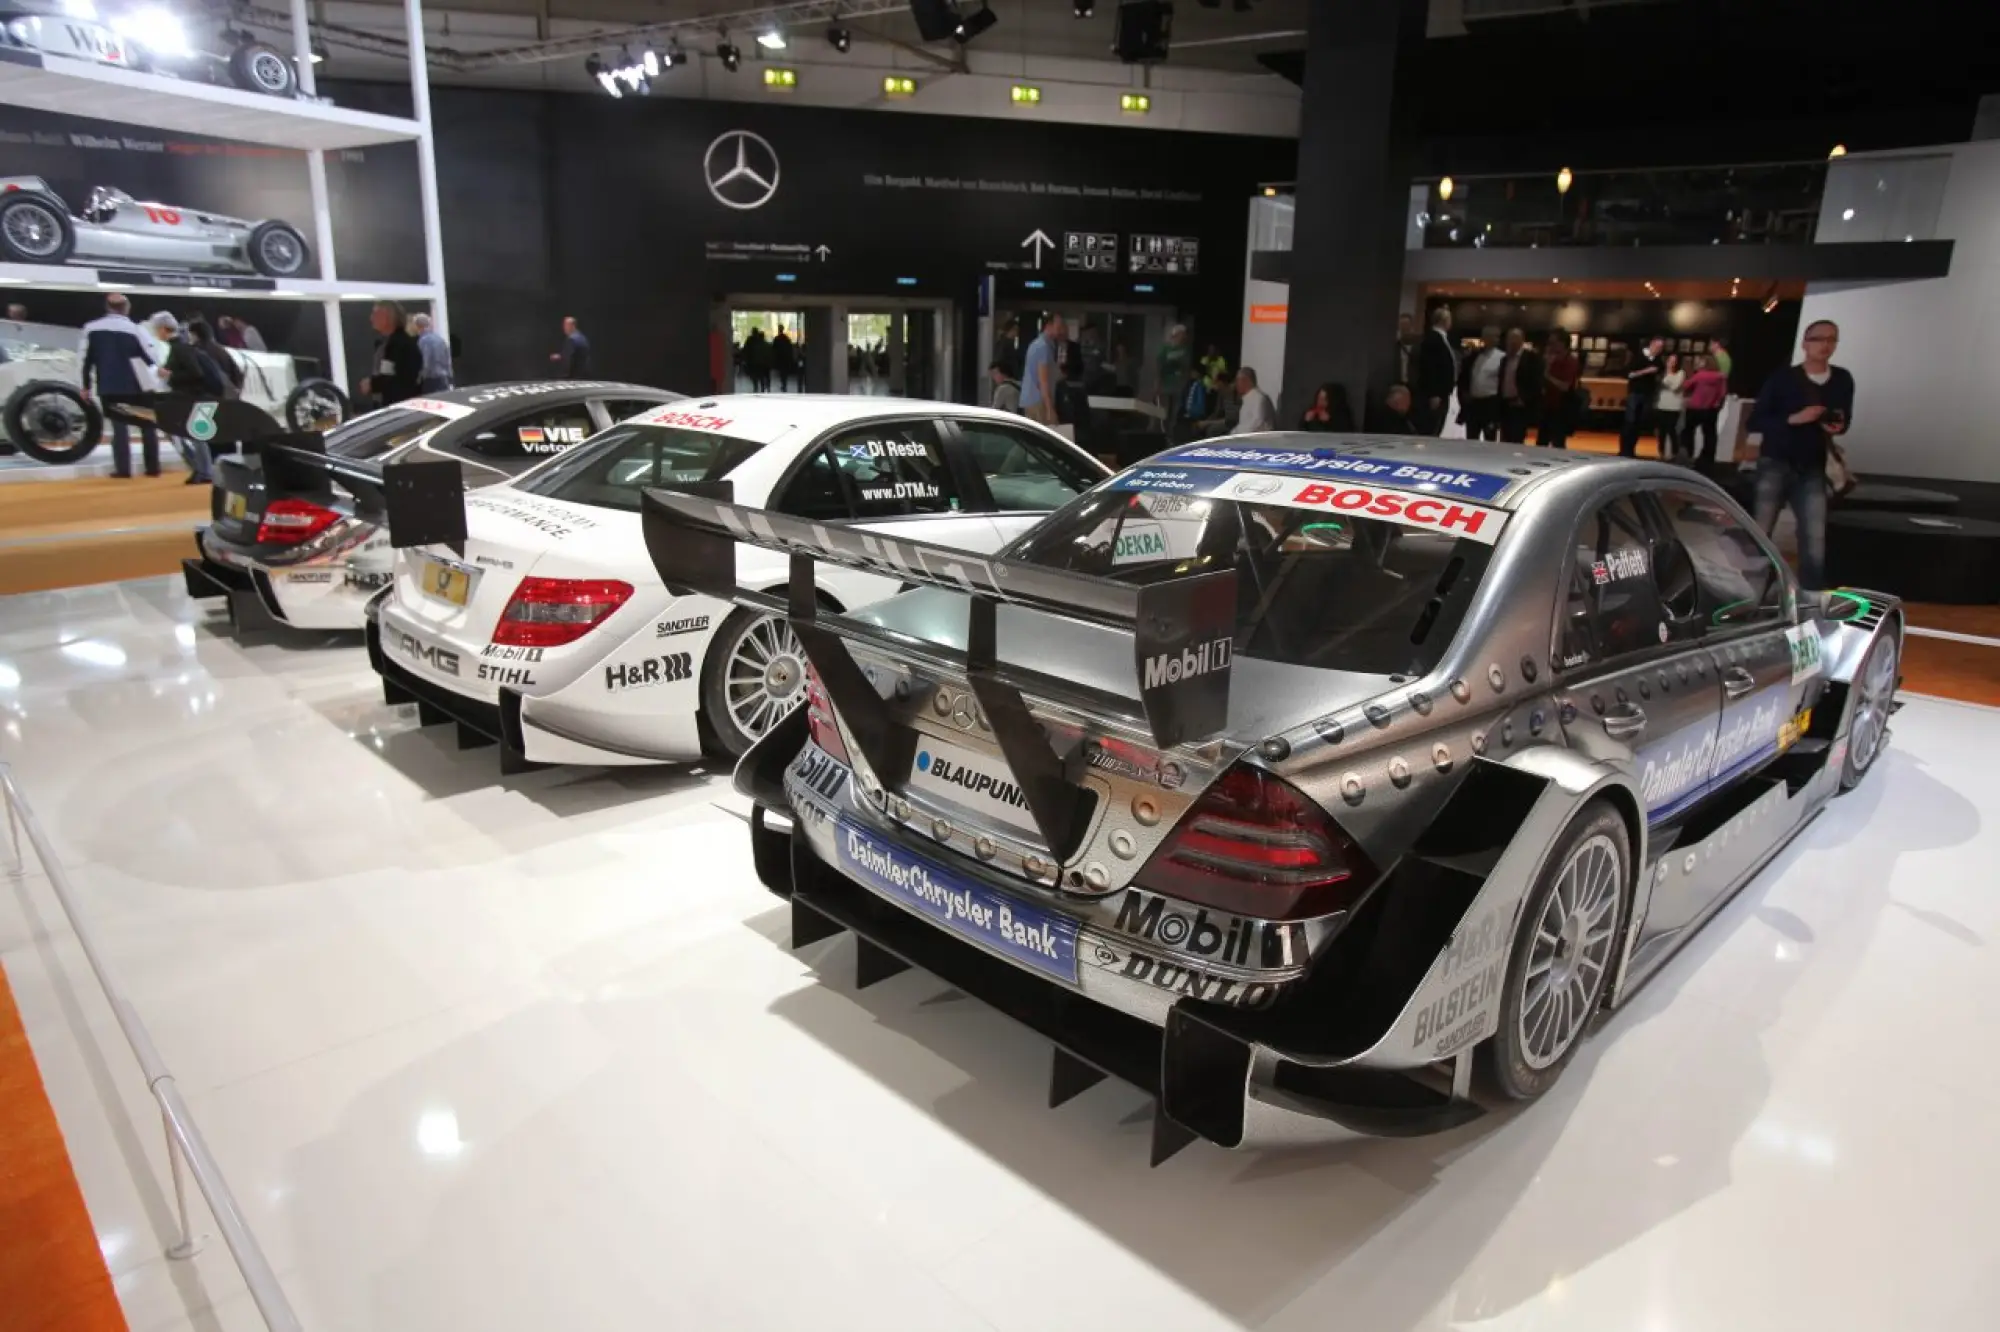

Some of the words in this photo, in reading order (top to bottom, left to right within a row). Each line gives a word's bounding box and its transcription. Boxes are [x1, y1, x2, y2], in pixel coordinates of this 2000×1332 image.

[867, 441, 885, 456] Di
[886, 440, 927, 456] Resta
[862, 482, 939, 500] www.DTM.tv
[1391, 464, 1478, 488] Bank
[1293, 483, 1488, 535] BOSCH
[1115, 532, 1164, 556] DEKRA
[657, 615, 709, 633] SANDTLER
[401, 634, 460, 677] AMG
[481, 645, 525, 662] Mobil
[1144, 642, 1211, 690] Mobil
[478, 664, 537, 686] STIHL
[605, 658, 660, 690] H&R
[847, 831, 994, 930] DaimlerChrysler
[998, 904, 1059, 960] Bank
[1113, 889, 1255, 967] Mobil
[1119, 951, 1287, 1010] DUNLO
[1413, 962, 1501, 1048] BILSTEIN
